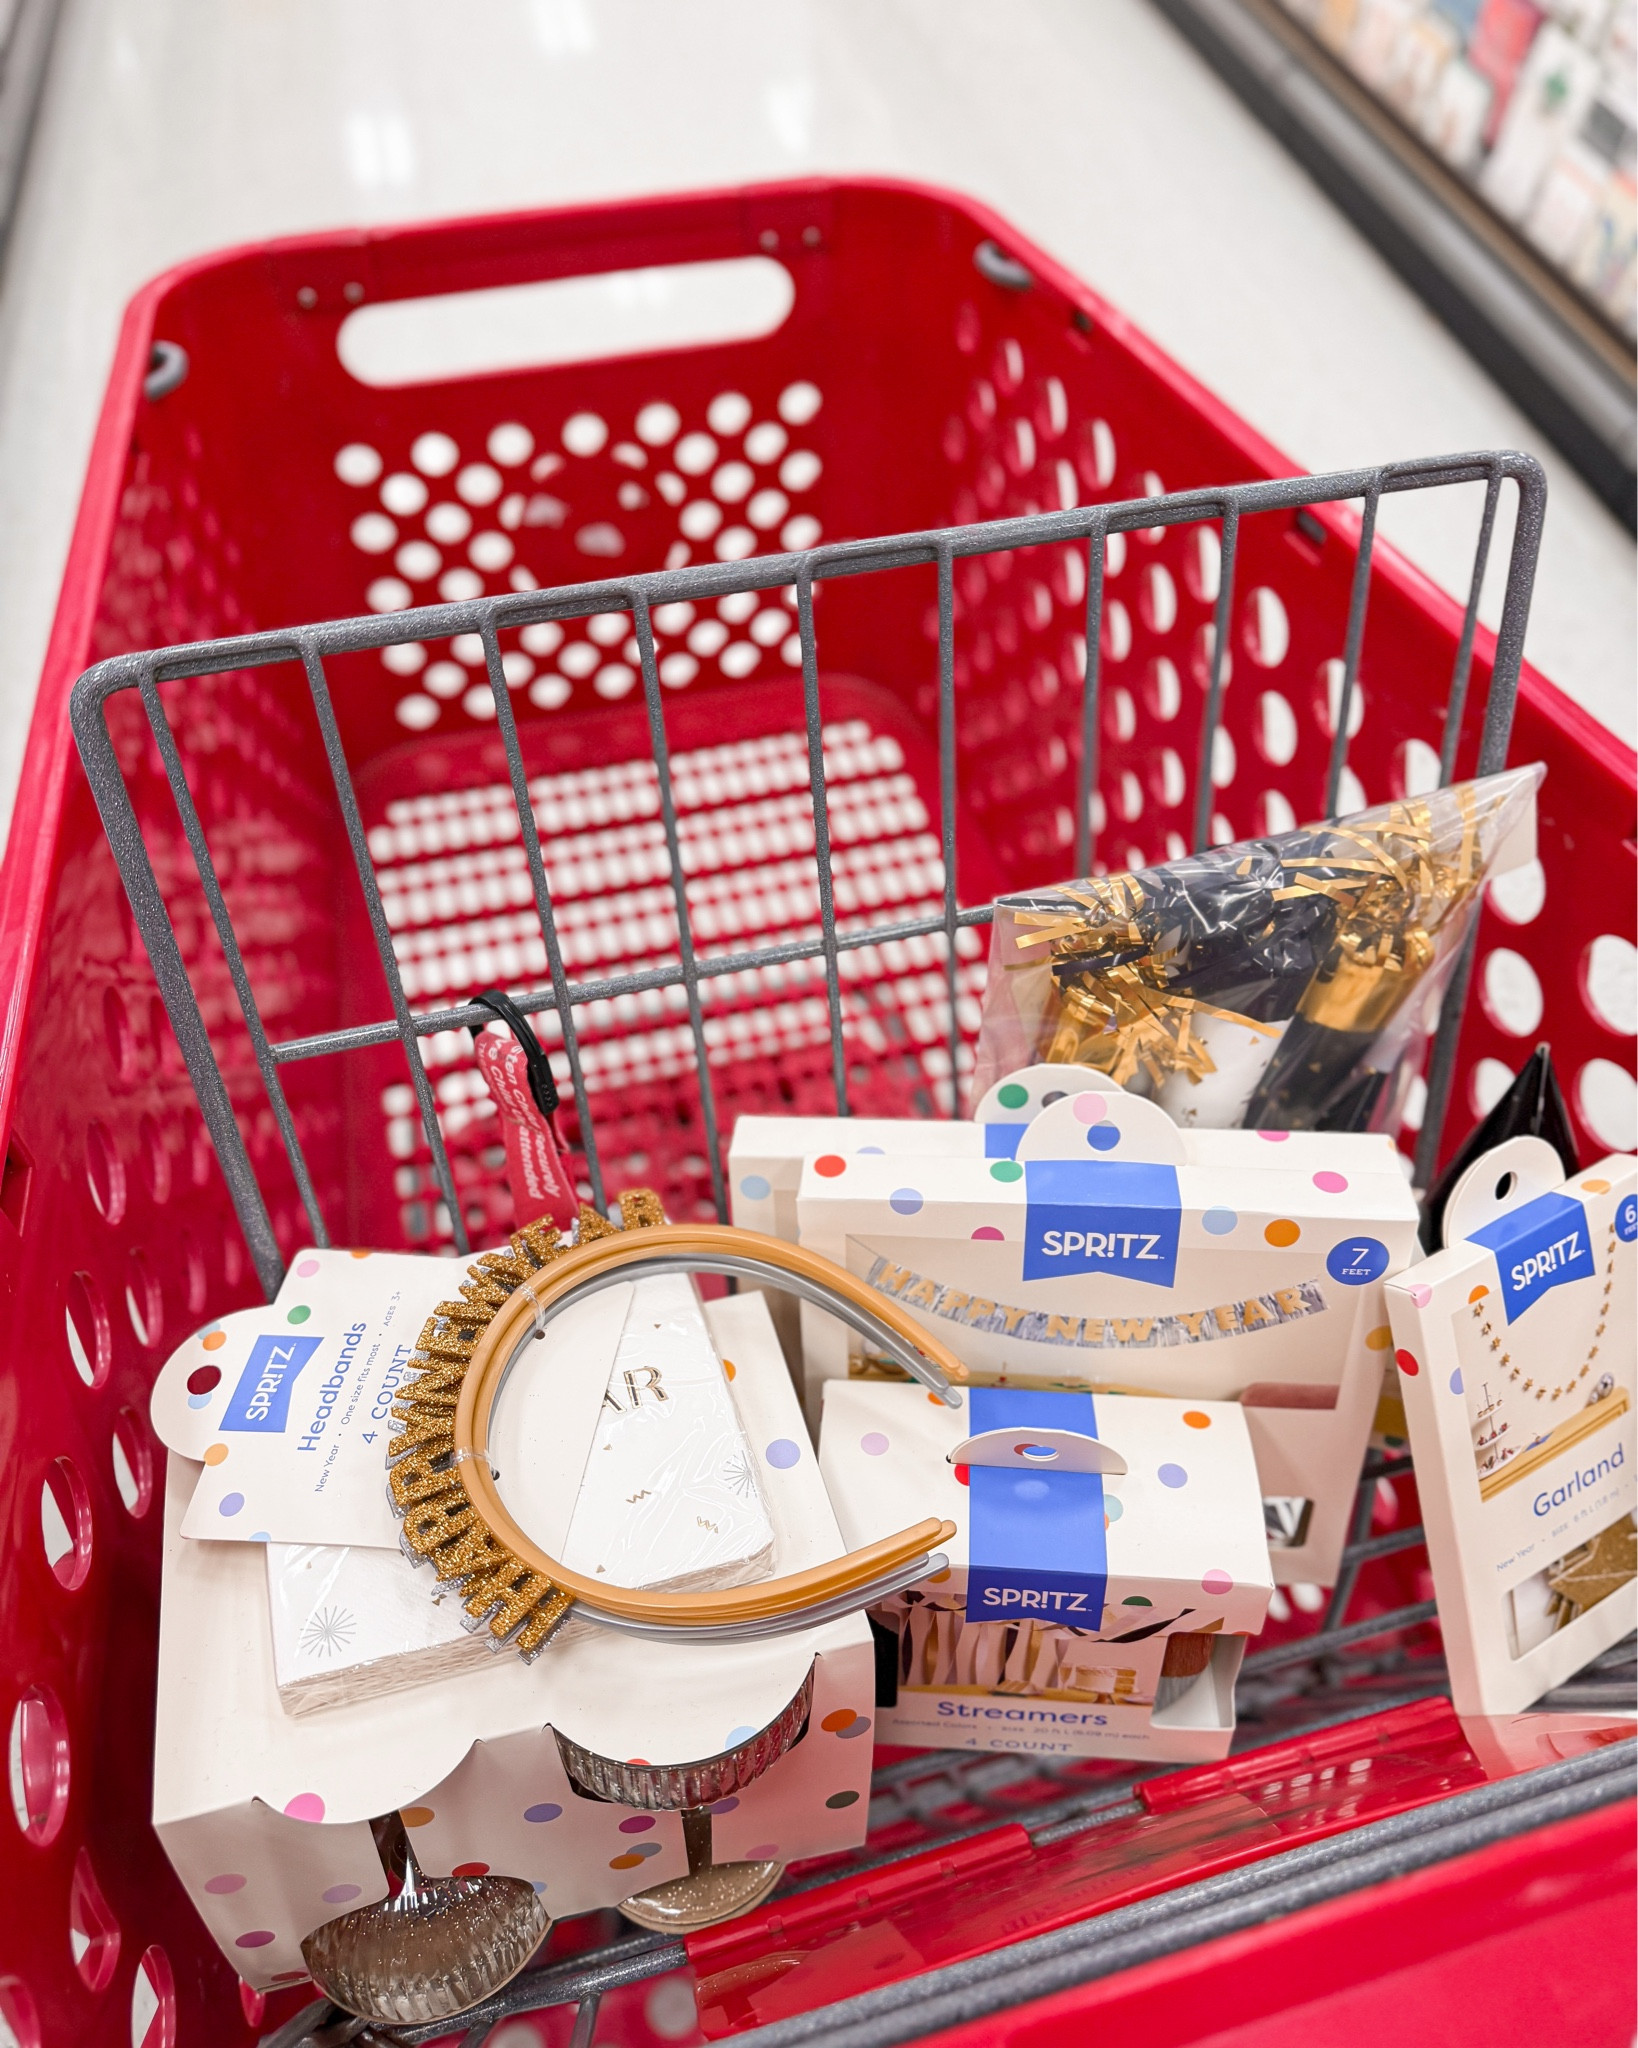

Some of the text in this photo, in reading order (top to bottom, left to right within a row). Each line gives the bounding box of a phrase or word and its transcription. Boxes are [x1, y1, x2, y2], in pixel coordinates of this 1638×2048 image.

[1624, 1204, 1637, 1223] 6
[1350, 1248, 1370, 1266] 7
[1341, 1268, 1371, 1276] FEET
[878, 1262, 1313, 1342] HAPPY NEW YEAR
[297, 1322, 367, 1451] Headbands
[314, 1469, 330, 1492] New
[324, 1444, 340, 1470] Year
[341, 1403, 356, 1425] One
[351, 1384, 364, 1403] size
[358, 1366, 371, 1383] fits
[366, 1343, 381, 1366] most
[383, 1305, 396, 1327] AGES
[361, 1345, 412, 1444] 4 COUNT
[1533, 1442, 1624, 1517] Garland
[1496, 1558, 1514, 1572] New
[1516, 1543, 1535, 1559] Year
[937, 1701, 1108, 1726] Streamers
[965, 1738, 1073, 1752] 4 COUNT
